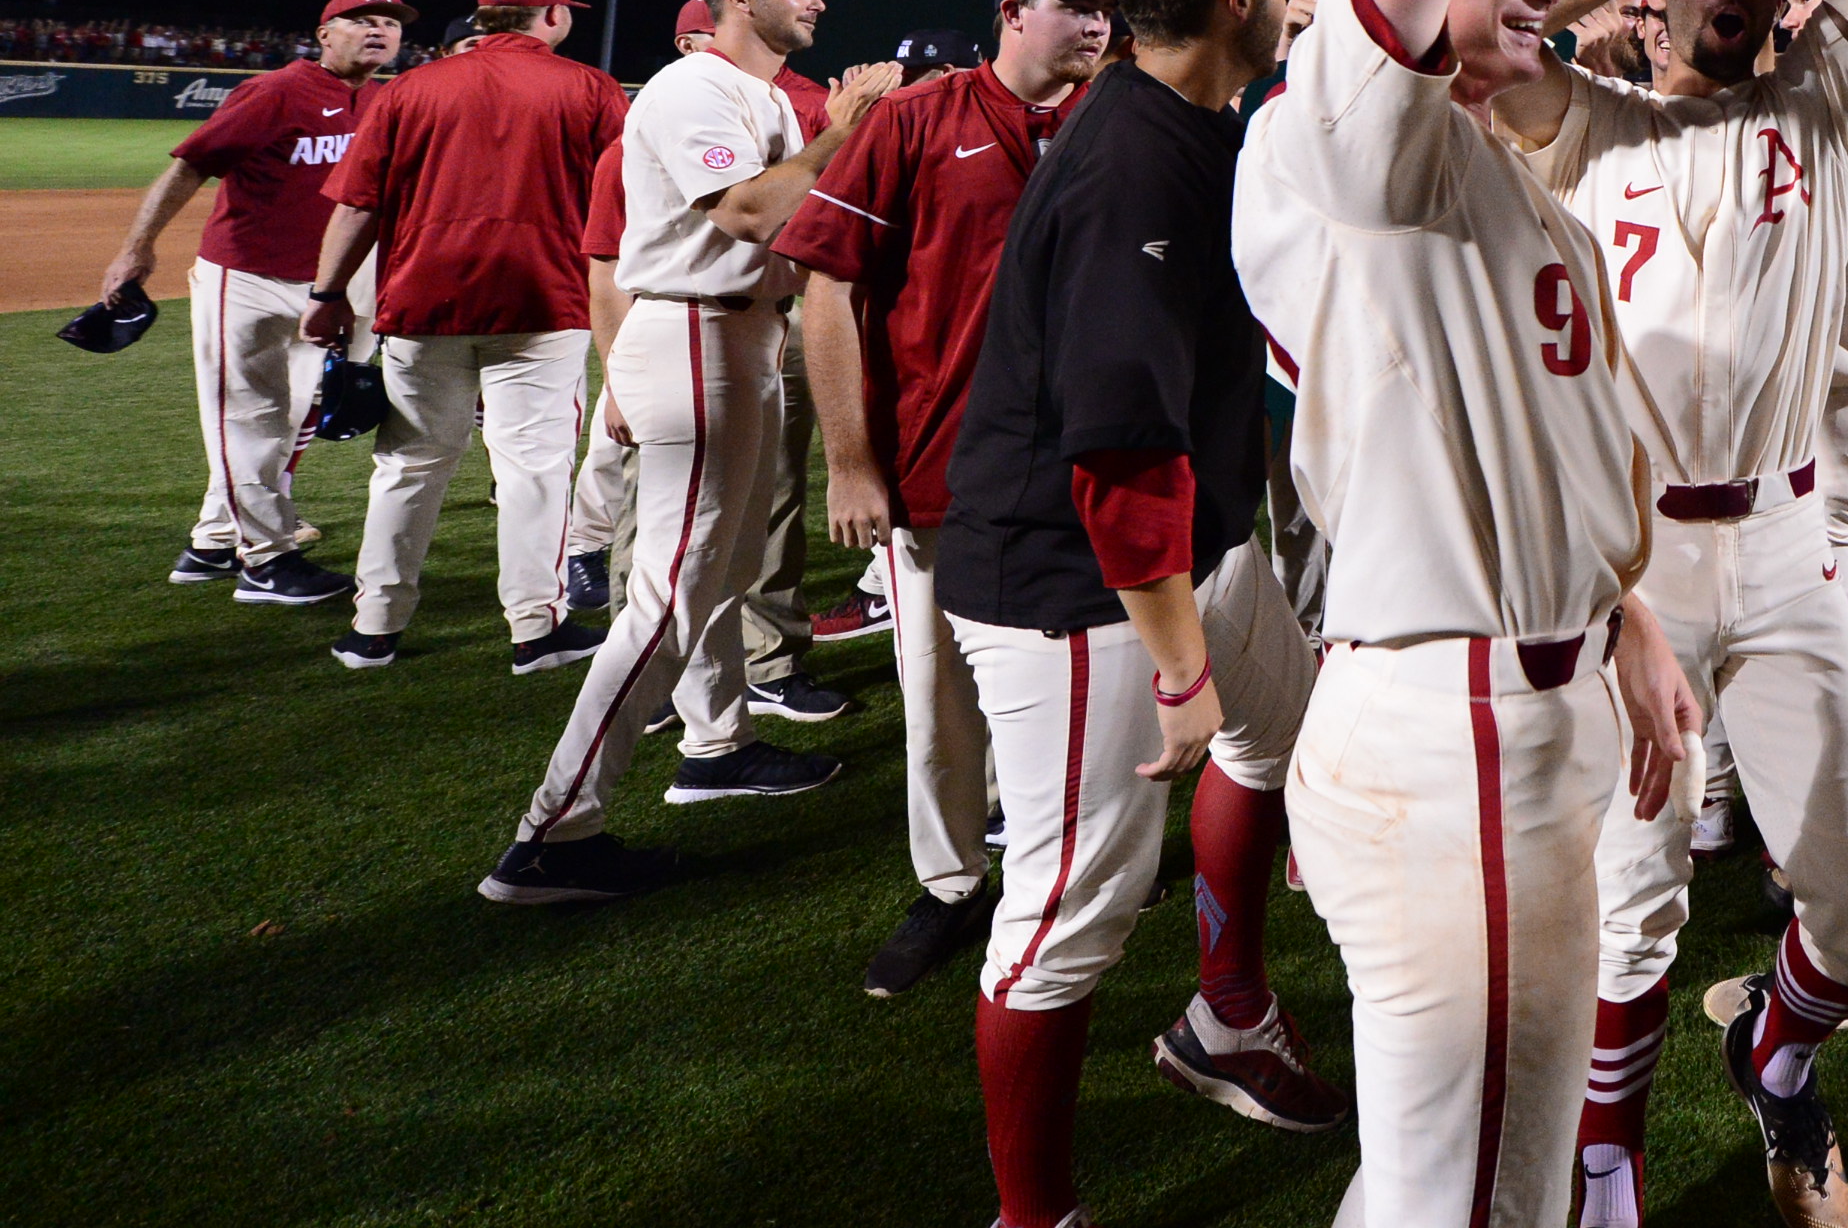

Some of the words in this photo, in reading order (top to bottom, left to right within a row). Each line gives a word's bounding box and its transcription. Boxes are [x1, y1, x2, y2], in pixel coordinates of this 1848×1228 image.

[1748, 127, 1813, 241] A
[1612, 219, 1661, 304] 7
[1533, 262, 1592, 378] 9
